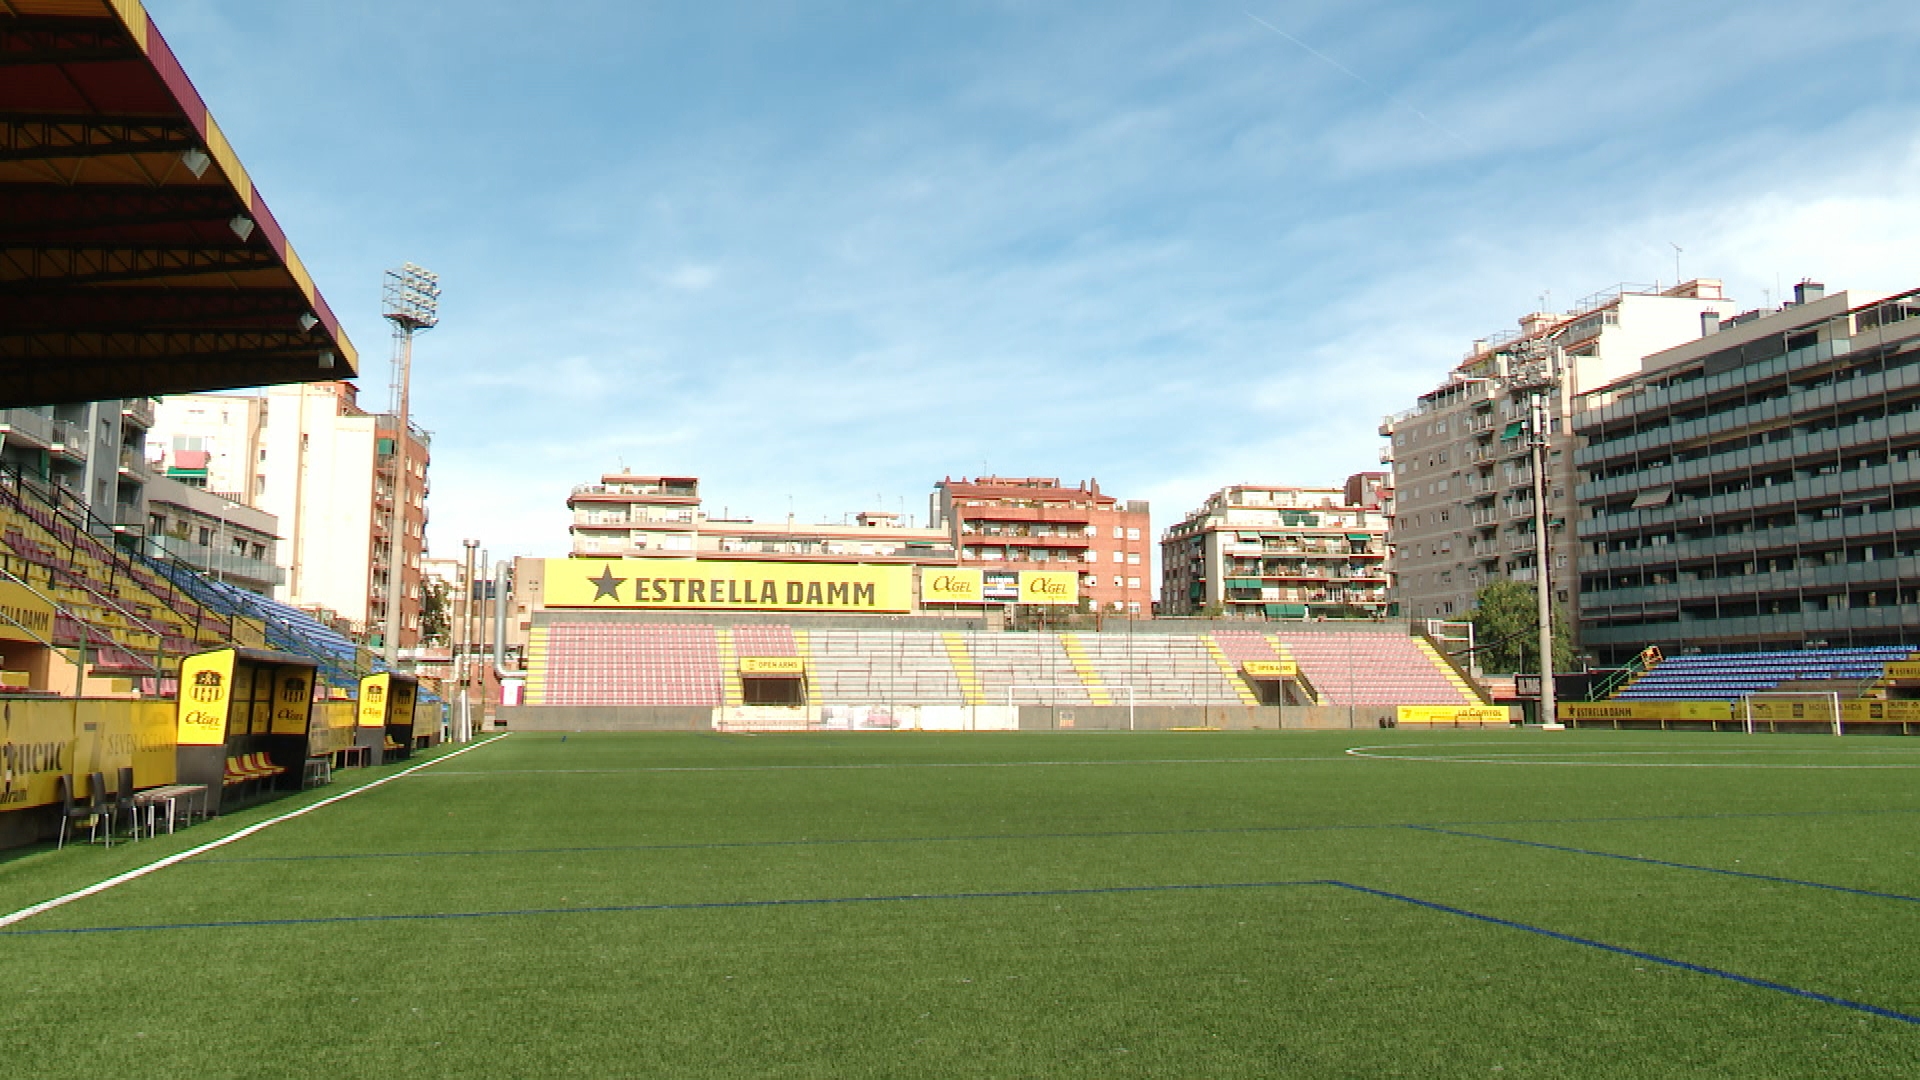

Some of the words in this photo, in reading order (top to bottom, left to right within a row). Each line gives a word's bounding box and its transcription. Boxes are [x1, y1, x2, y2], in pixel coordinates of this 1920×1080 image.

[635, 579, 778, 604] ESTRELLA
[786, 581, 875, 606] DAMM
[22, 609, 49, 631] DAMM
[1577, 707, 1608, 717] ESTRELLA
[1609, 707, 1632, 717] DAMM
[107, 733, 137, 756] SEVEN
